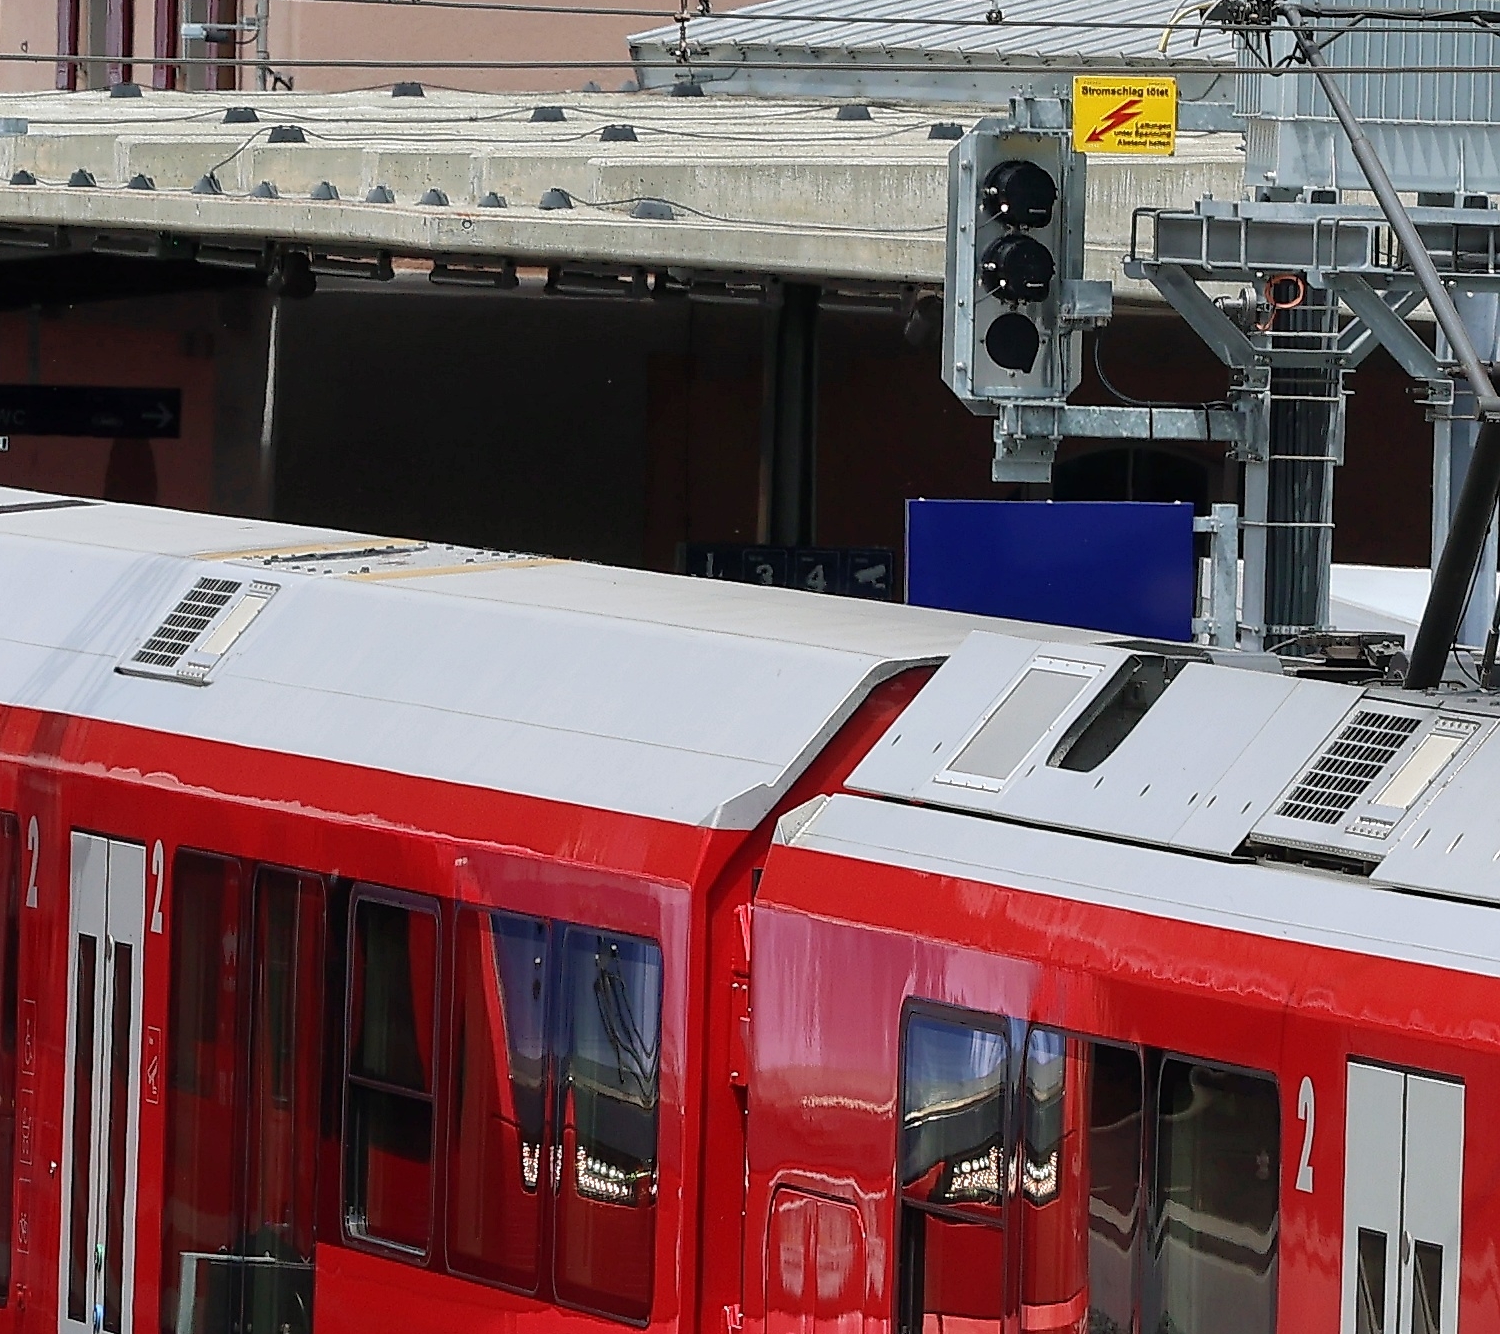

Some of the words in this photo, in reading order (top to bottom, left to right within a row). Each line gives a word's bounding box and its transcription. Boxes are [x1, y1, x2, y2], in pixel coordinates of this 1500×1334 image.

[25, 815, 39, 909] 2
[150, 839, 164, 934] 2
[1295, 1076, 1315, 1194] 2
